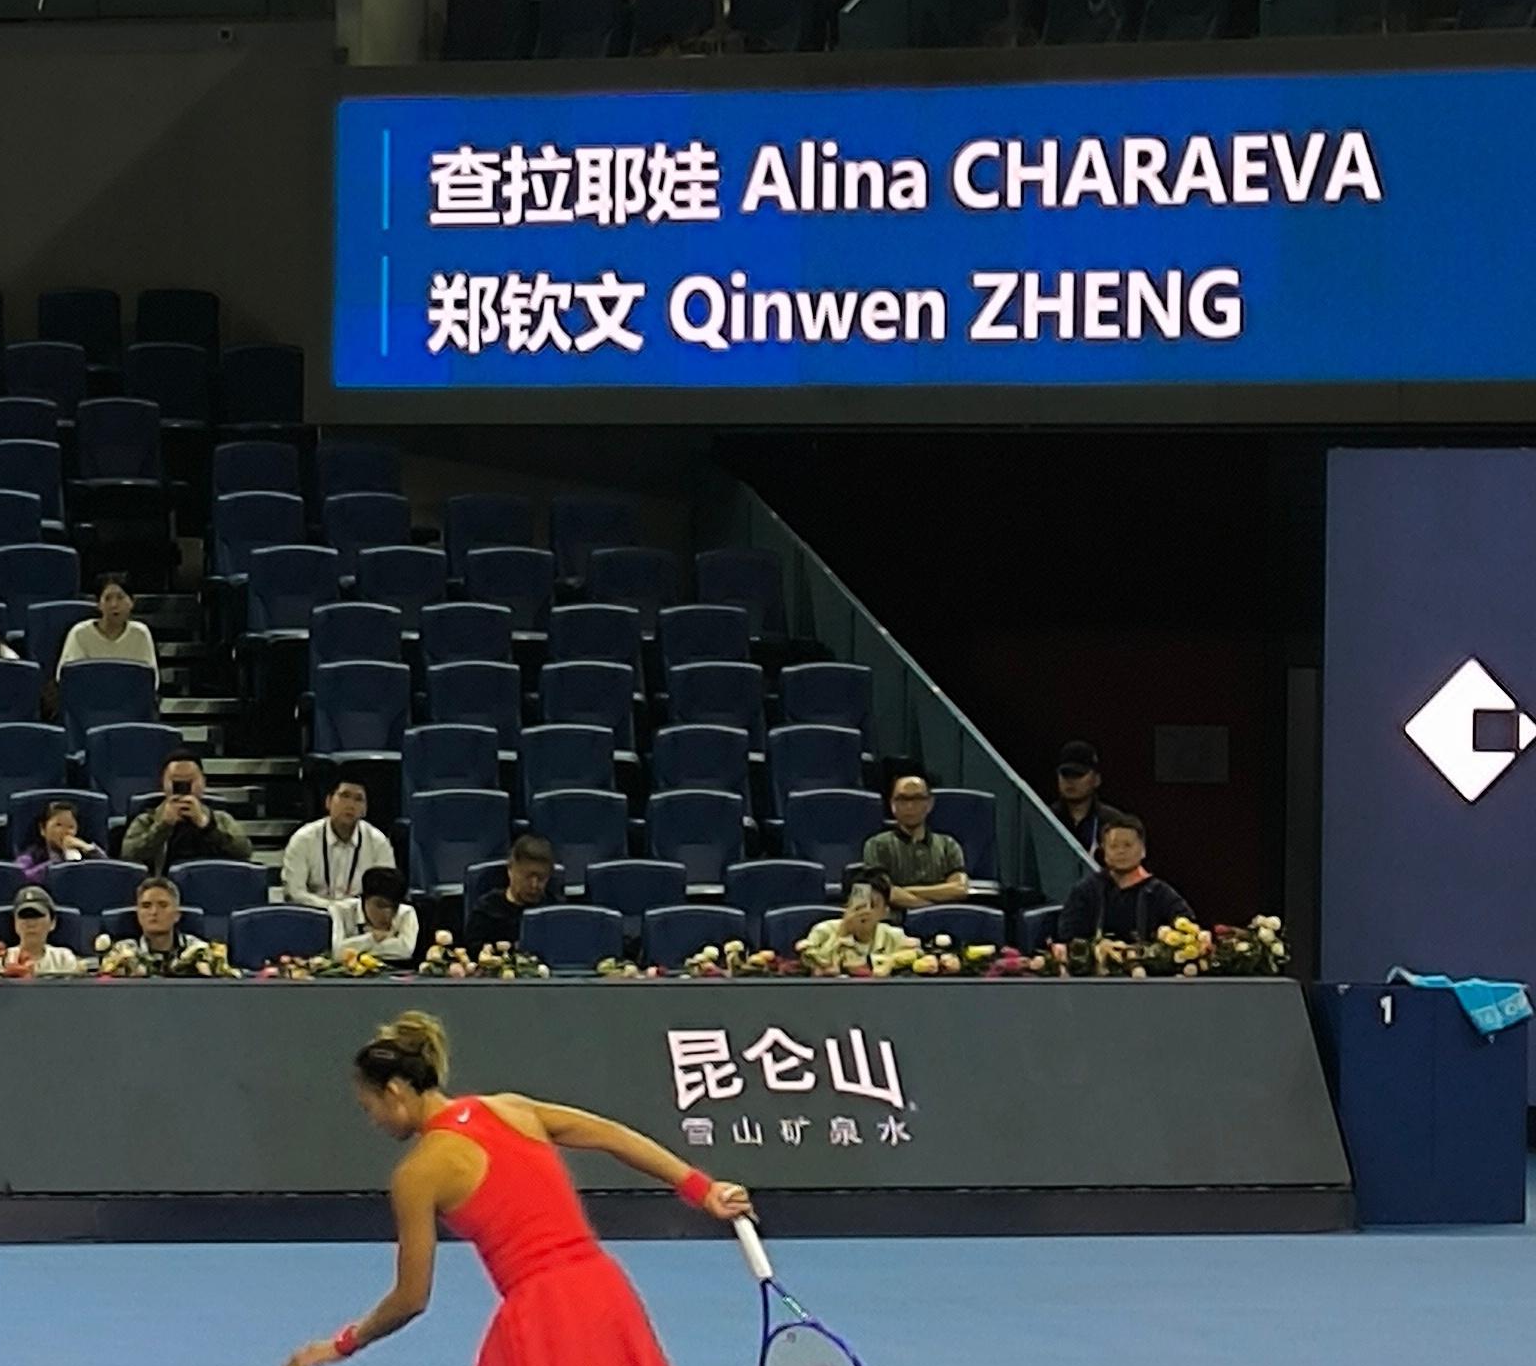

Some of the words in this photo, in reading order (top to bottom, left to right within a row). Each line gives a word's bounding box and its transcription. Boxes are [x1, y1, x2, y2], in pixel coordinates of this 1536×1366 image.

[428, 141, 722, 226] 查拉耶娃
[741, 140, 928, 212] Alina
[952, 131, 1382, 210] CHARAEVA
[426, 271, 646, 355] 郑钦文
[668, 271, 946, 350] Qinwen
[969, 268, 1242, 341] ZHENG
[1379, 995, 1393, 1025] 1
[666, 1026, 905, 1111] 昆仑山
[681, 1115, 913, 1147] 雪山矿泉水
